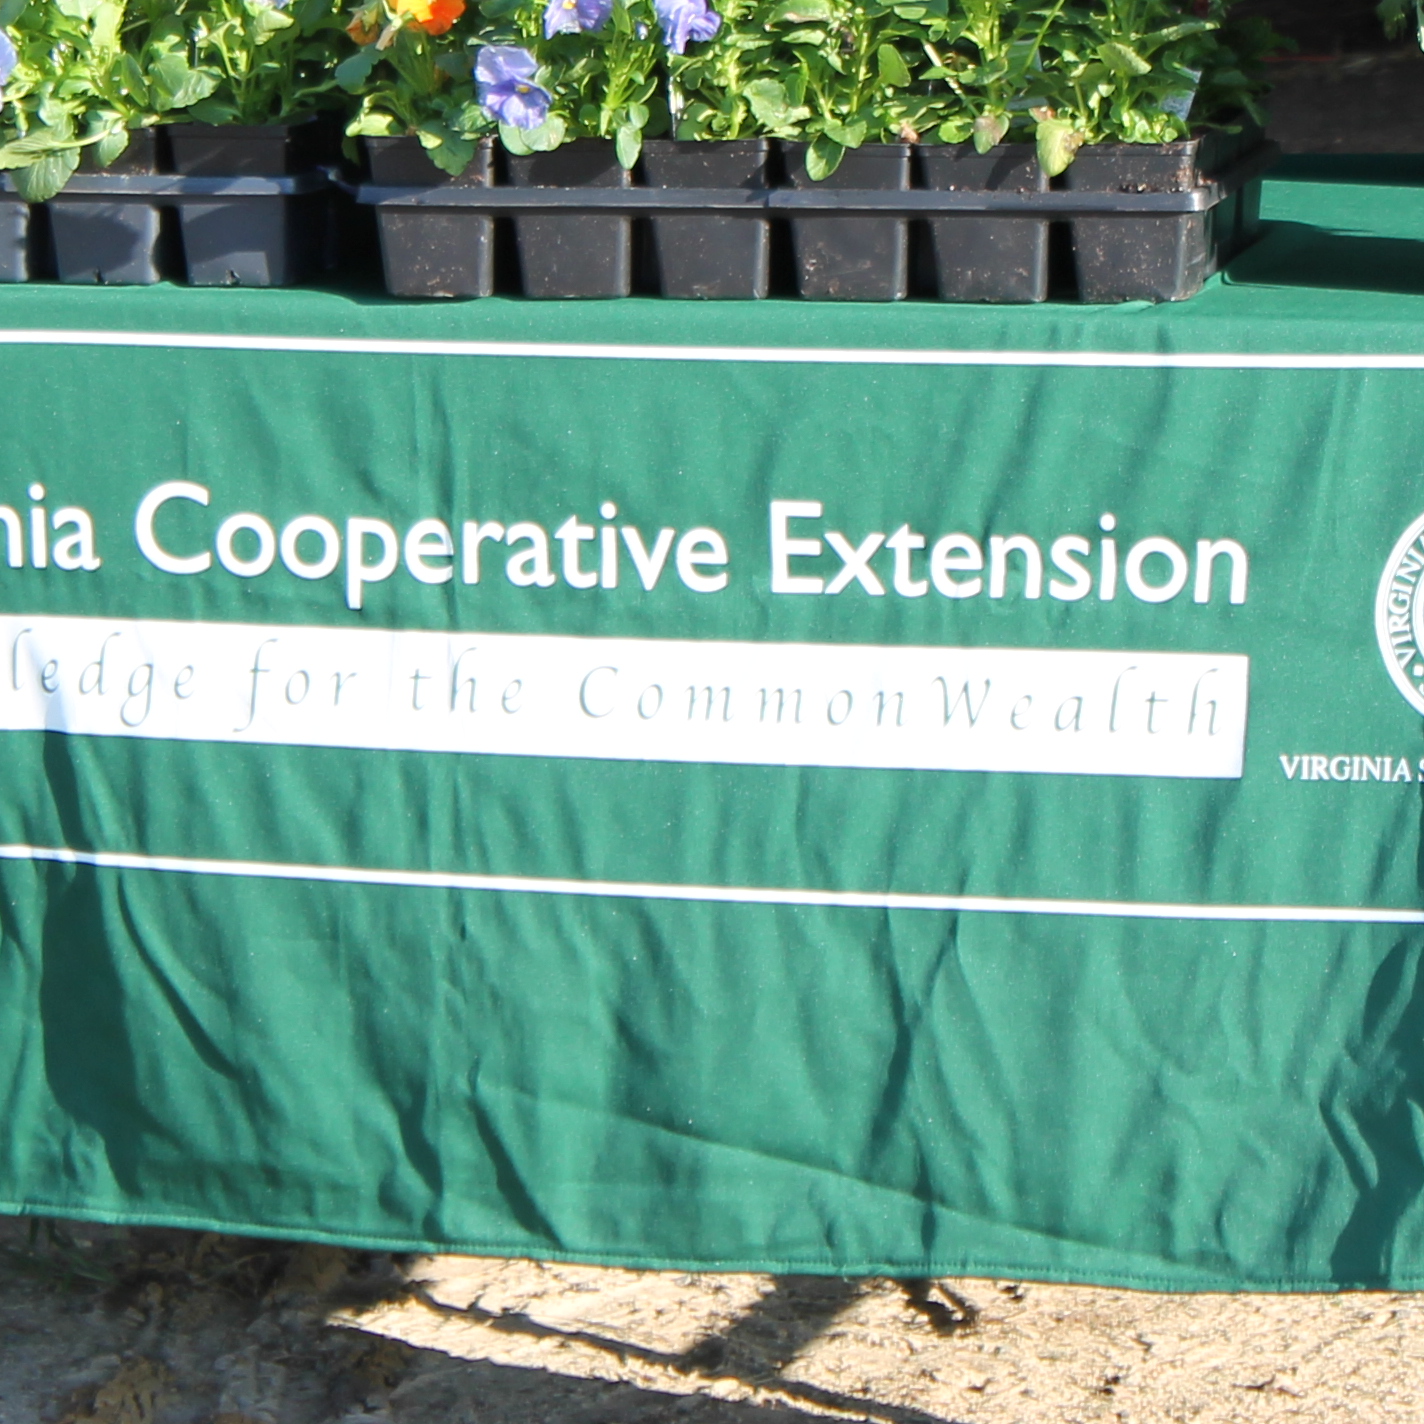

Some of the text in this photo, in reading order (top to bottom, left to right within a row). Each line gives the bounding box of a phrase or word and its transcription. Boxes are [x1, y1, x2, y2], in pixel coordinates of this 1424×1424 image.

[134, 480, 729, 611] Cooperative
[770, 499, 1249, 605] Extension
[232, 637, 359, 733] for
[409, 646, 523, 716] the
[578, 664, 1220, 736] CommonWealth
[1279, 753, 1411, 782] VIRGINIA
